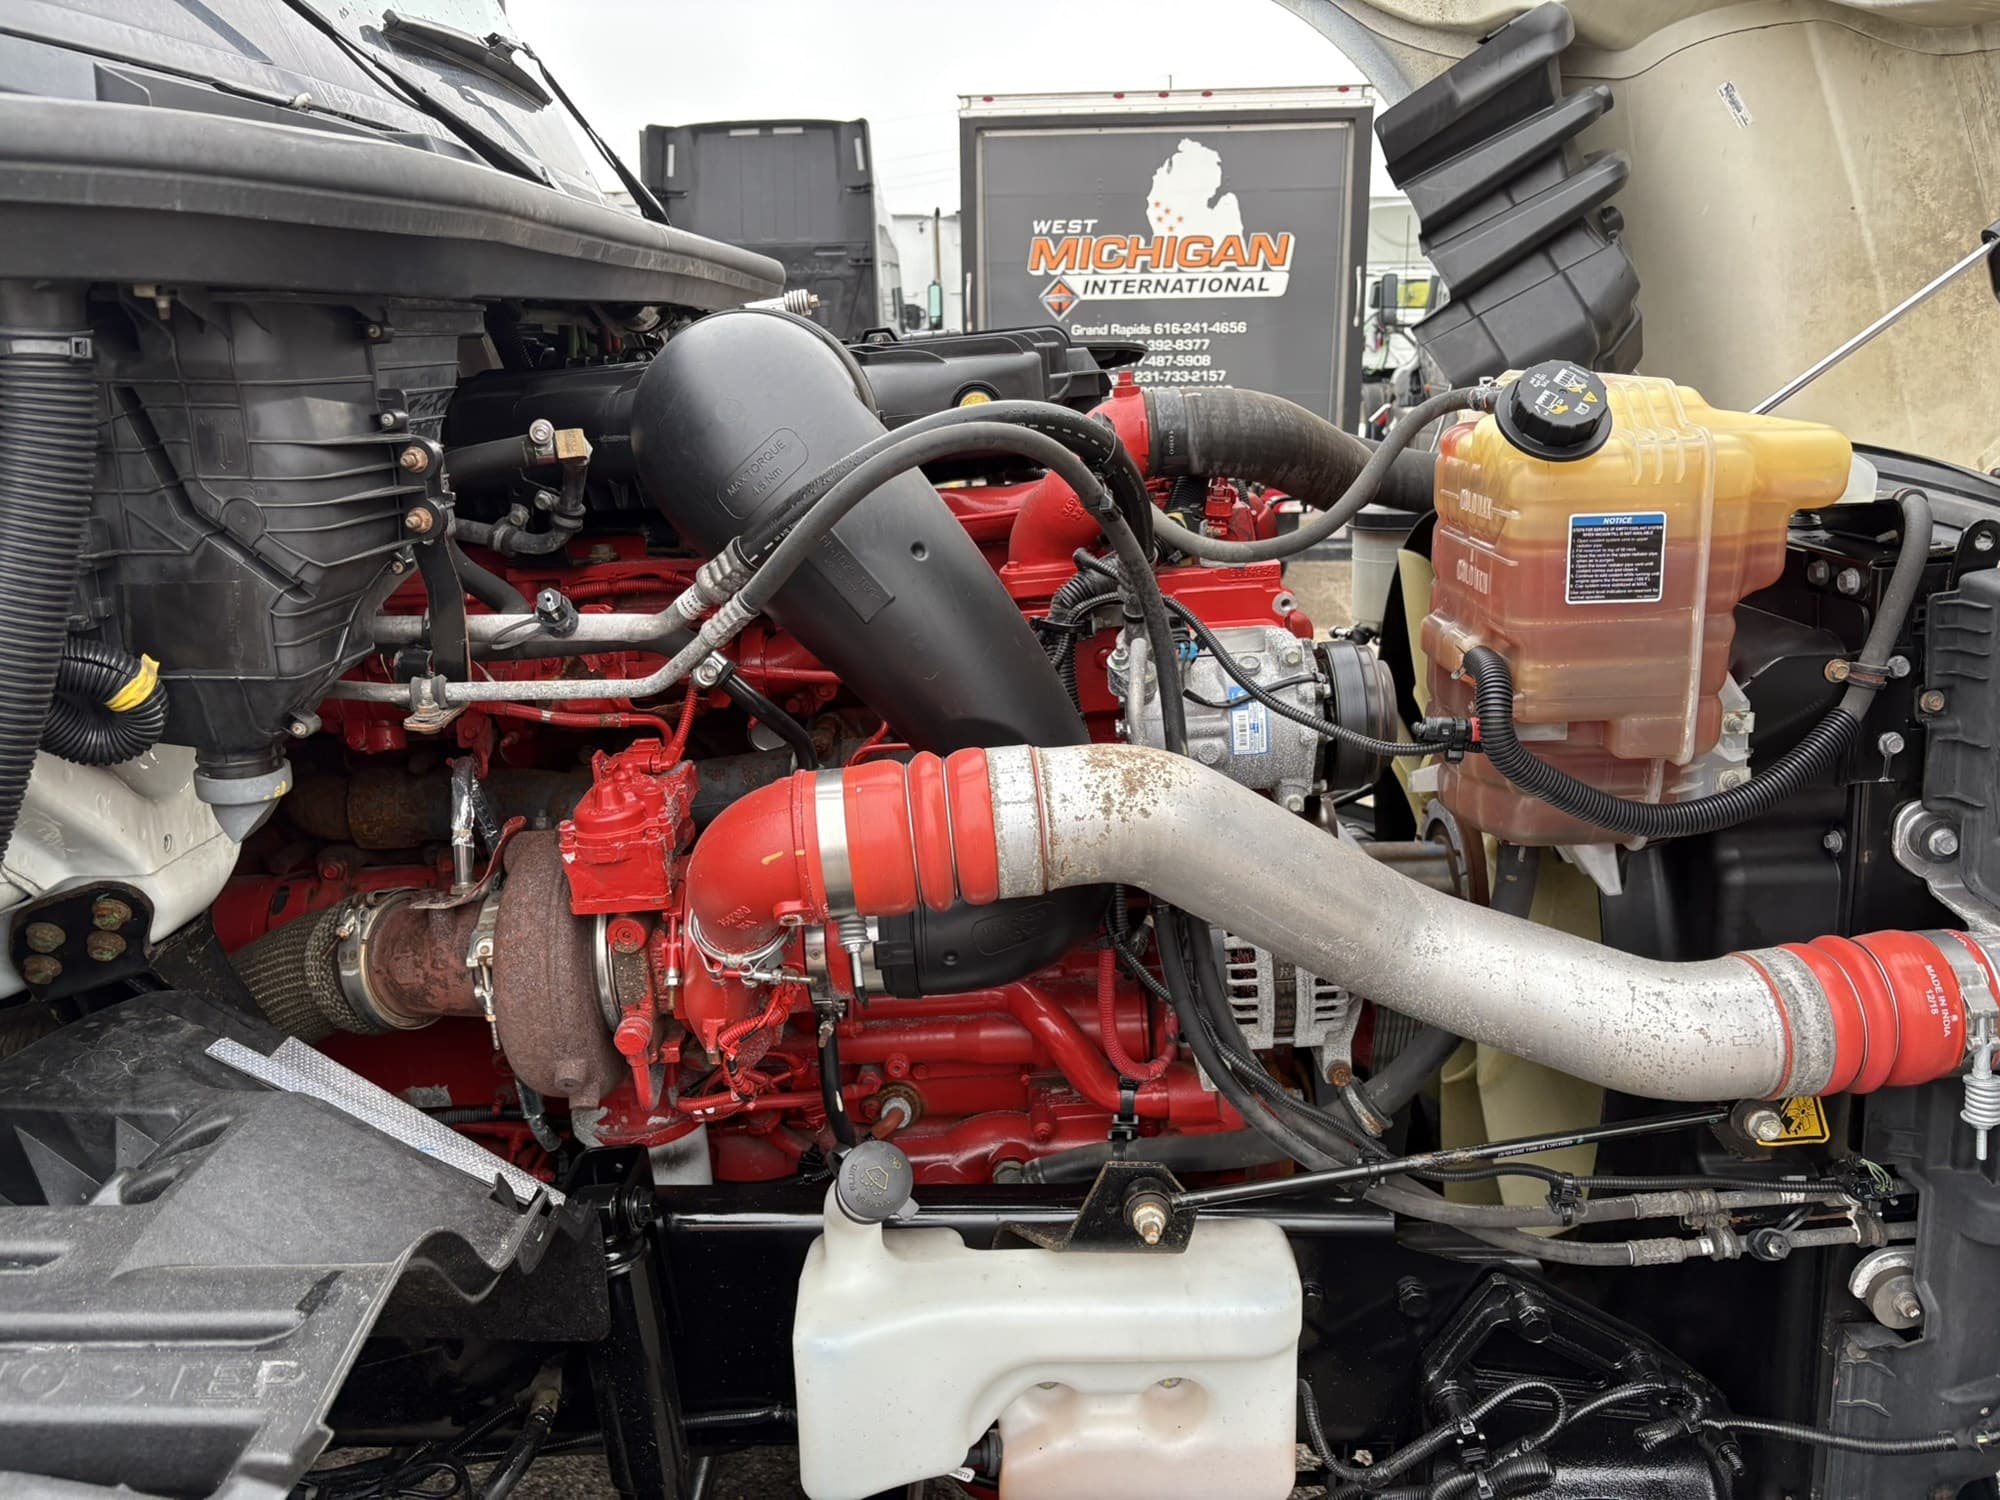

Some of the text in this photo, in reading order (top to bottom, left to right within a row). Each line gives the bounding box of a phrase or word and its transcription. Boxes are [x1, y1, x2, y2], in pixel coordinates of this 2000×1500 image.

[1032, 219, 1098, 234] WEST
[1028, 232, 1293, 274] MICHIGAN
[1083, 277, 1270, 295] INTERNATIONAL
[1071, 322, 1247, 338] Grand Rapids 616-241-4656
[1121, 355, 1211, 367] 7-487-5908
[1134, 371, 1226, 383] 231-733-2157
[744, 440, 786, 478] TORQUE
[1924, 964, 1951, 1037] MADE IN INDIA
